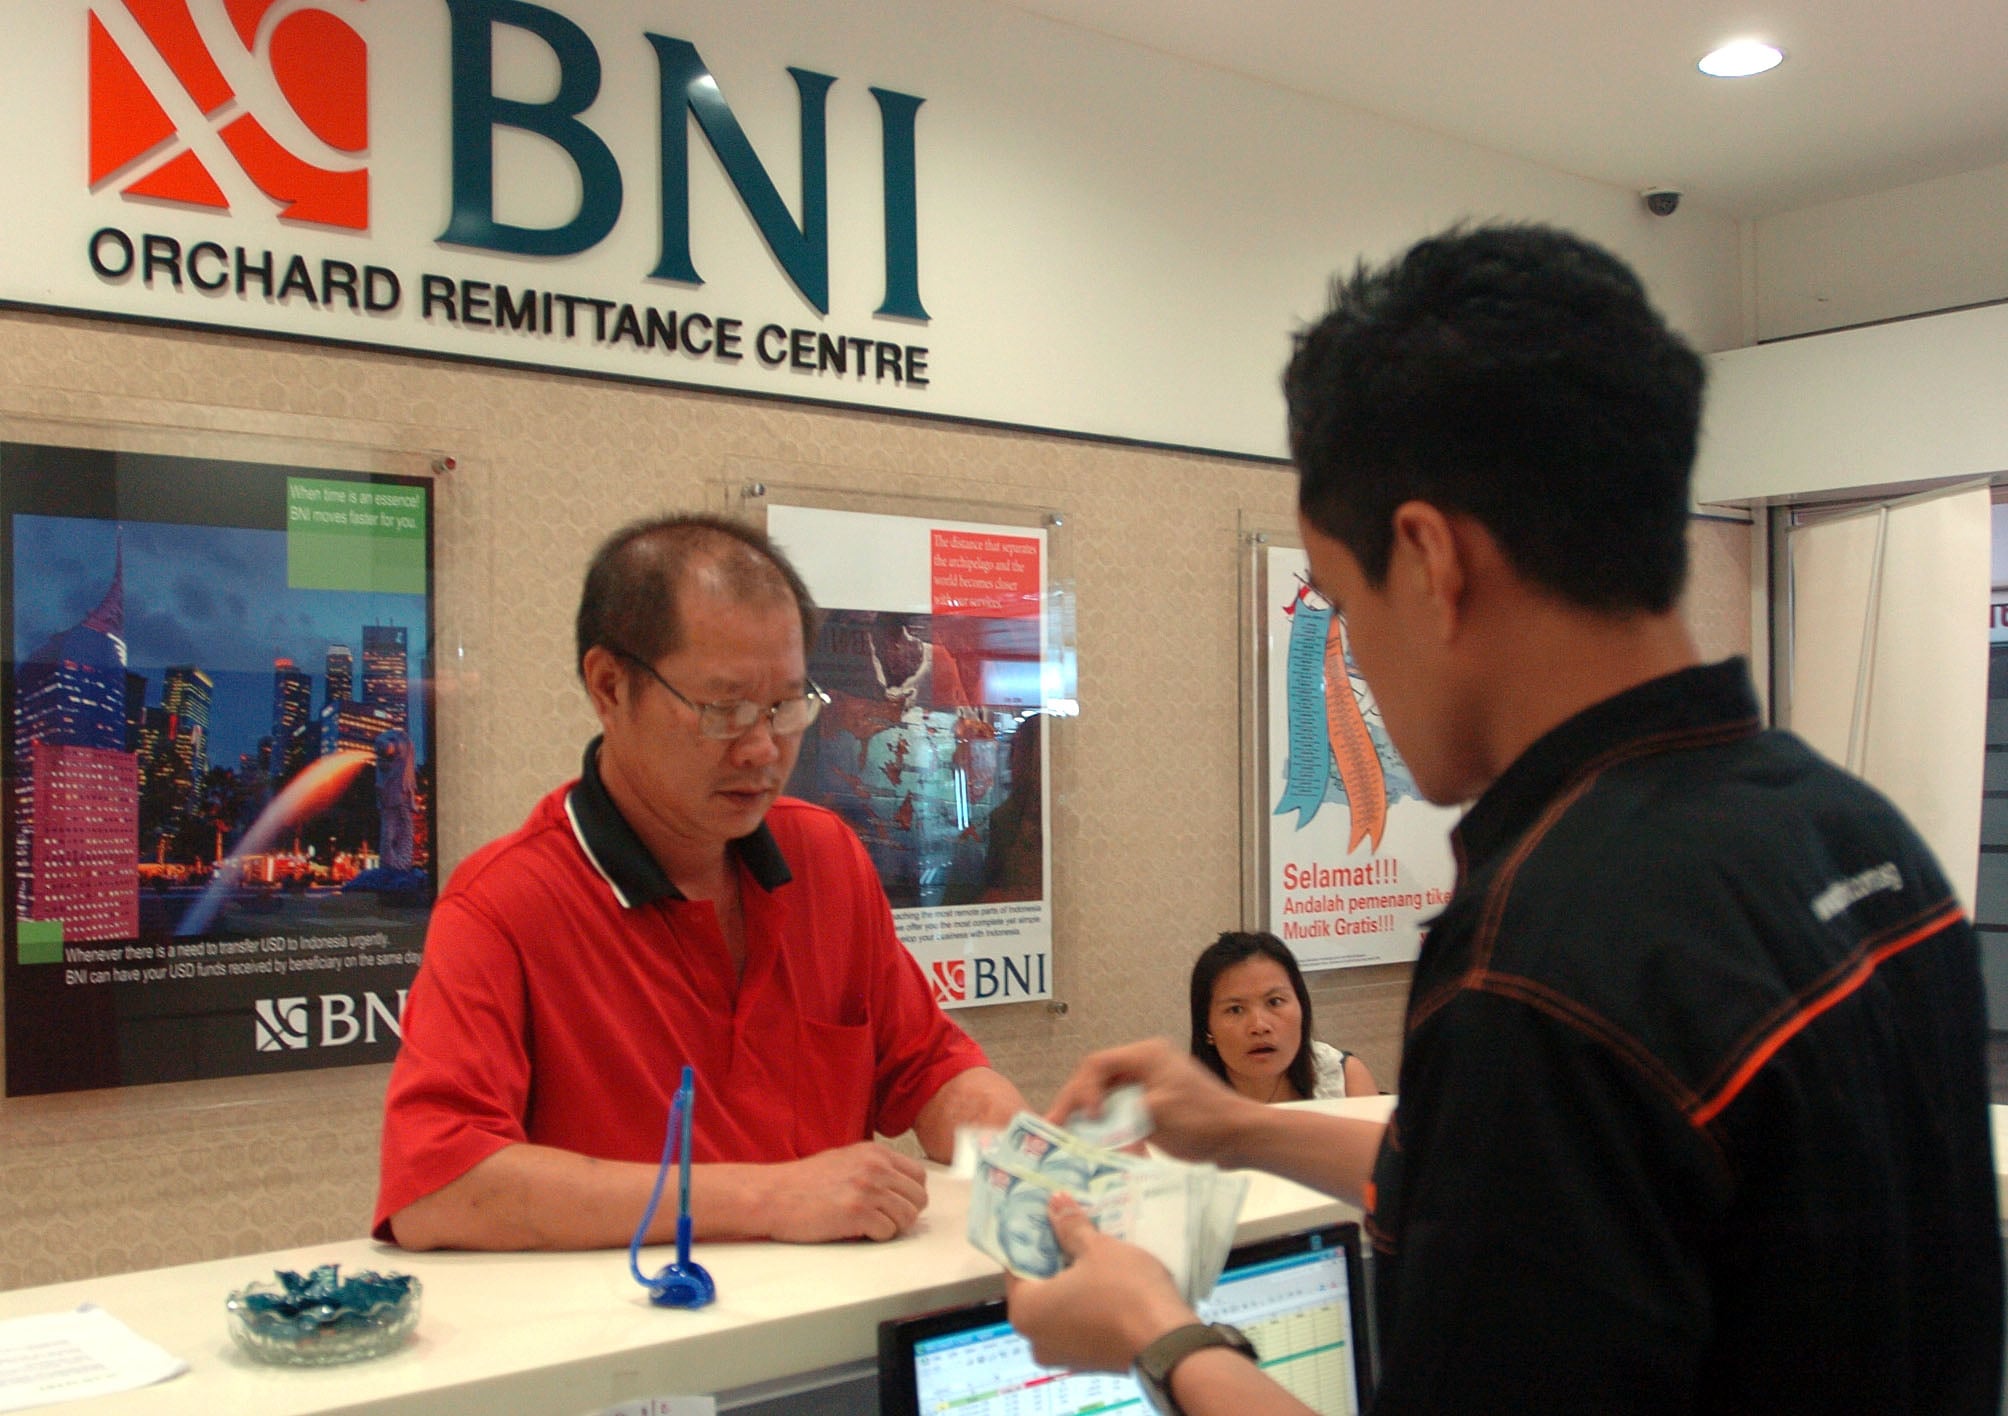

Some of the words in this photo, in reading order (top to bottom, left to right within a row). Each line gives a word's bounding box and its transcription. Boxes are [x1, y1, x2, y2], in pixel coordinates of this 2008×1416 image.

[435, 0, 931, 321] BNI
[88, 228, 401, 311] ORCHARD
[421, 273, 742, 361] REMITTANCE
[755, 325, 930, 385] CENTRE
[289, 483, 321, 501] When
[323, 487, 346, 503] time
[348, 491, 358, 504] is
[360, 493, 373, 505] an
[289, 504, 311, 521] BNI
[313, 511, 347, 524] moves
[349, 508, 378, 526] faster
[380, 511, 394, 528] for
[934, 534, 948, 548] The
[950, 536, 983, 551] distance
[984, 538, 1000, 552] that
[1002, 542, 1037, 557] separates
[934, 554, 947, 568] the
[949, 556, 994, 574] archipelago
[995, 559, 1010, 573] and
[1011, 560, 1024, 574] the
[934, 574, 958, 588] world
[959, 574, 993, 590] becomes
[995, 576, 1018, 591] closer
[1283, 858, 1398, 891] Selamat!!!
[1283, 895, 1345, 915] Andalah
[1348, 892, 1423, 914] pemenang
[1427, 887, 1452, 906] tike
[1283, 919, 1331, 941] Mudik
[1335, 914, 1395, 936] Gratis!!!
[65, 947, 122, 963] Whenever
[124, 945, 154, 960] there
[155, 943, 166, 959] is
[167, 946, 176, 958] a
[177, 942, 204, 957] need
[206, 941, 218, 955] to
[219, 937, 260, 955] transfer
[261, 936, 286, 952] USD
[287, 936, 298, 951] to
[299, 935, 349, 950] Indonesia
[65, 968, 88, 985] BNI
[90, 969, 111, 983] can
[112, 967, 141, 981] have
[142, 967, 168, 984] your
[168, 962, 195, 979] USD
[197, 961, 227, 977] funds
[228, 959, 273, 975] received
[274, 957, 287, 975] by
[288, 954, 343, 973] beneficiary
[343, 955, 358, 968] on
[358, 952, 375, 967] the
[375, 952, 404, 966] same
[974, 953, 1046, 999] BNI
[319, 989, 409, 1047] BN
